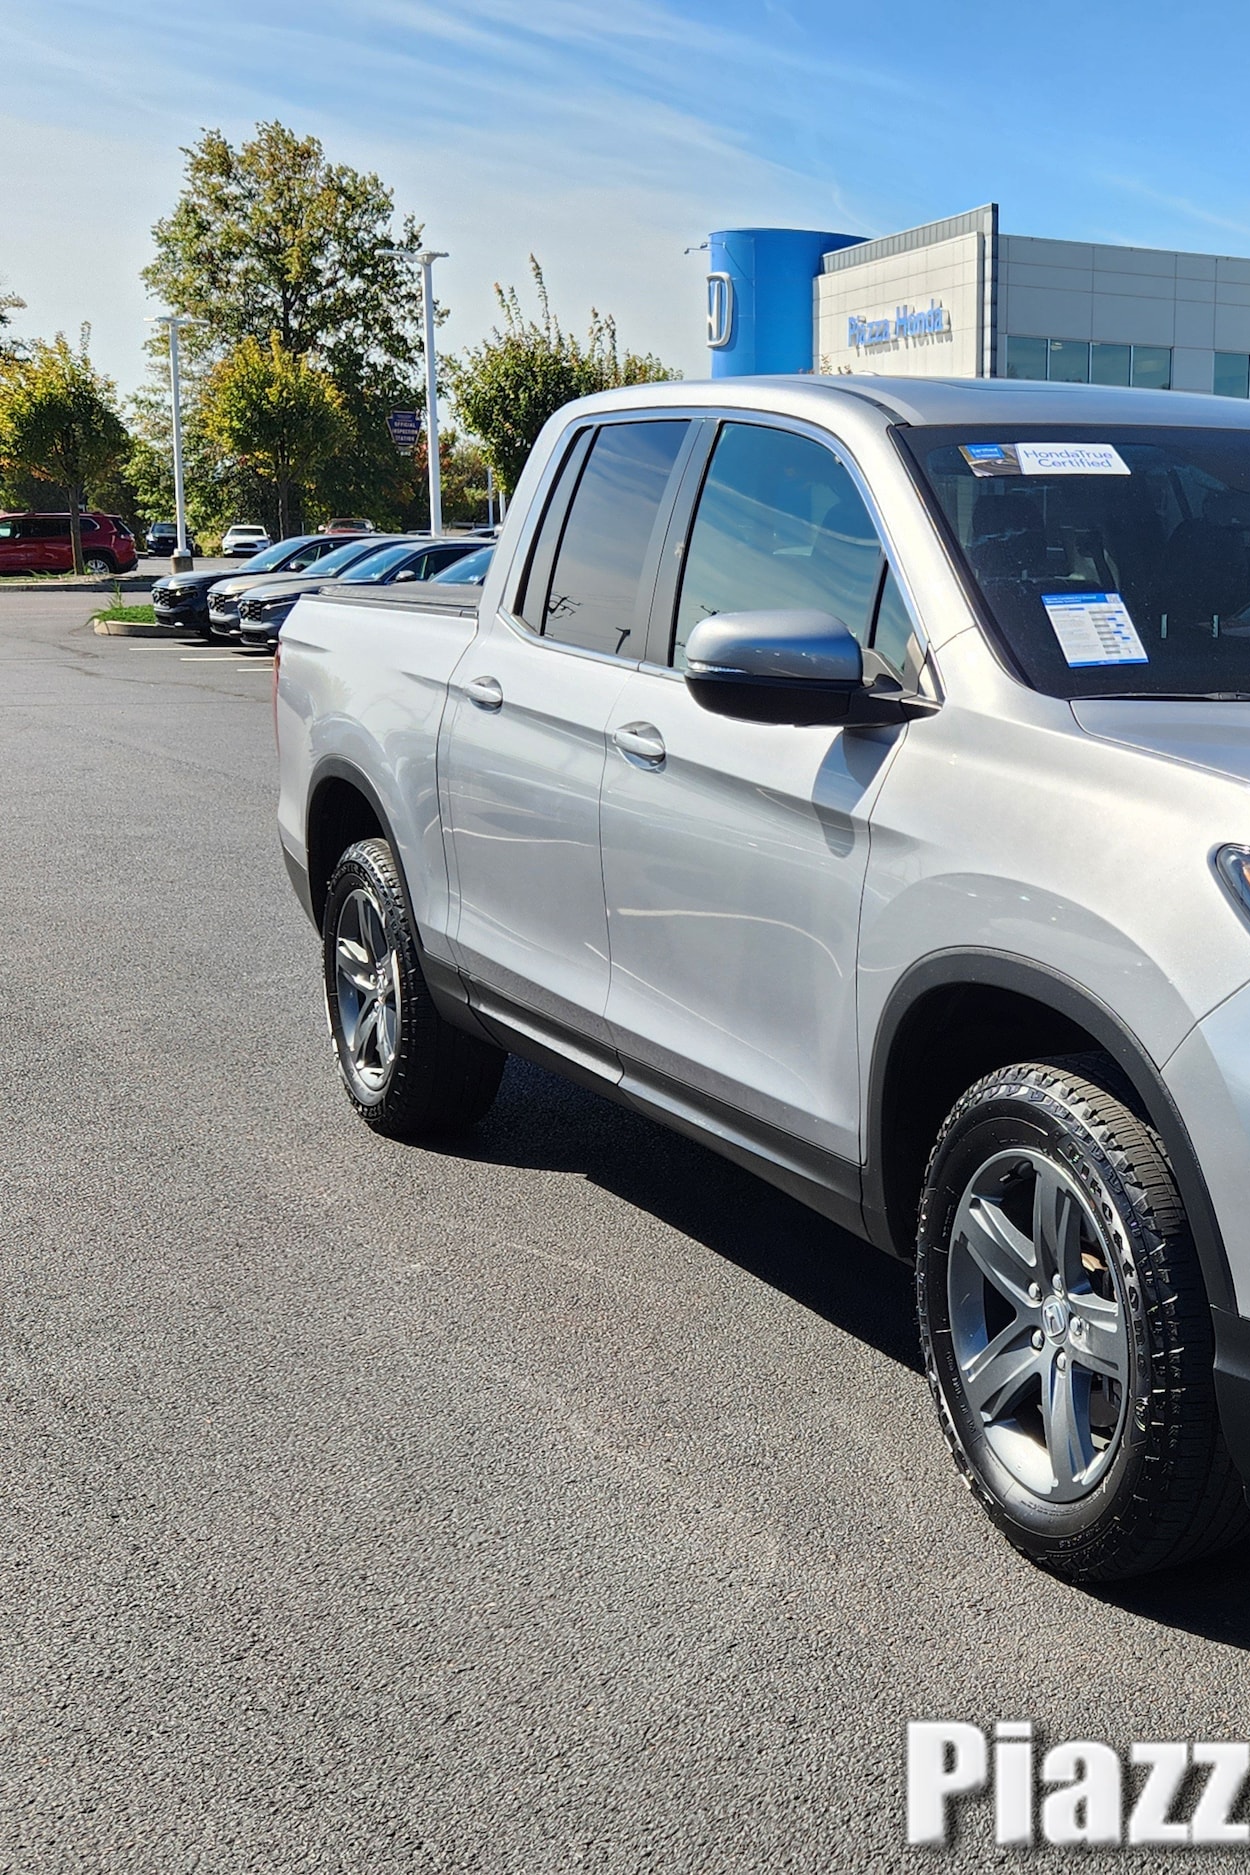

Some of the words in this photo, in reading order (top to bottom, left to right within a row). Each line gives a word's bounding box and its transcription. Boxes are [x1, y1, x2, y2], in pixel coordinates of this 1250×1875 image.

[848, 316, 890, 347] Piazza
[896, 298, 943, 337] Honda
[1023, 449, 1113, 460] HondaTrue
[1038, 458, 1112, 468] Certified
